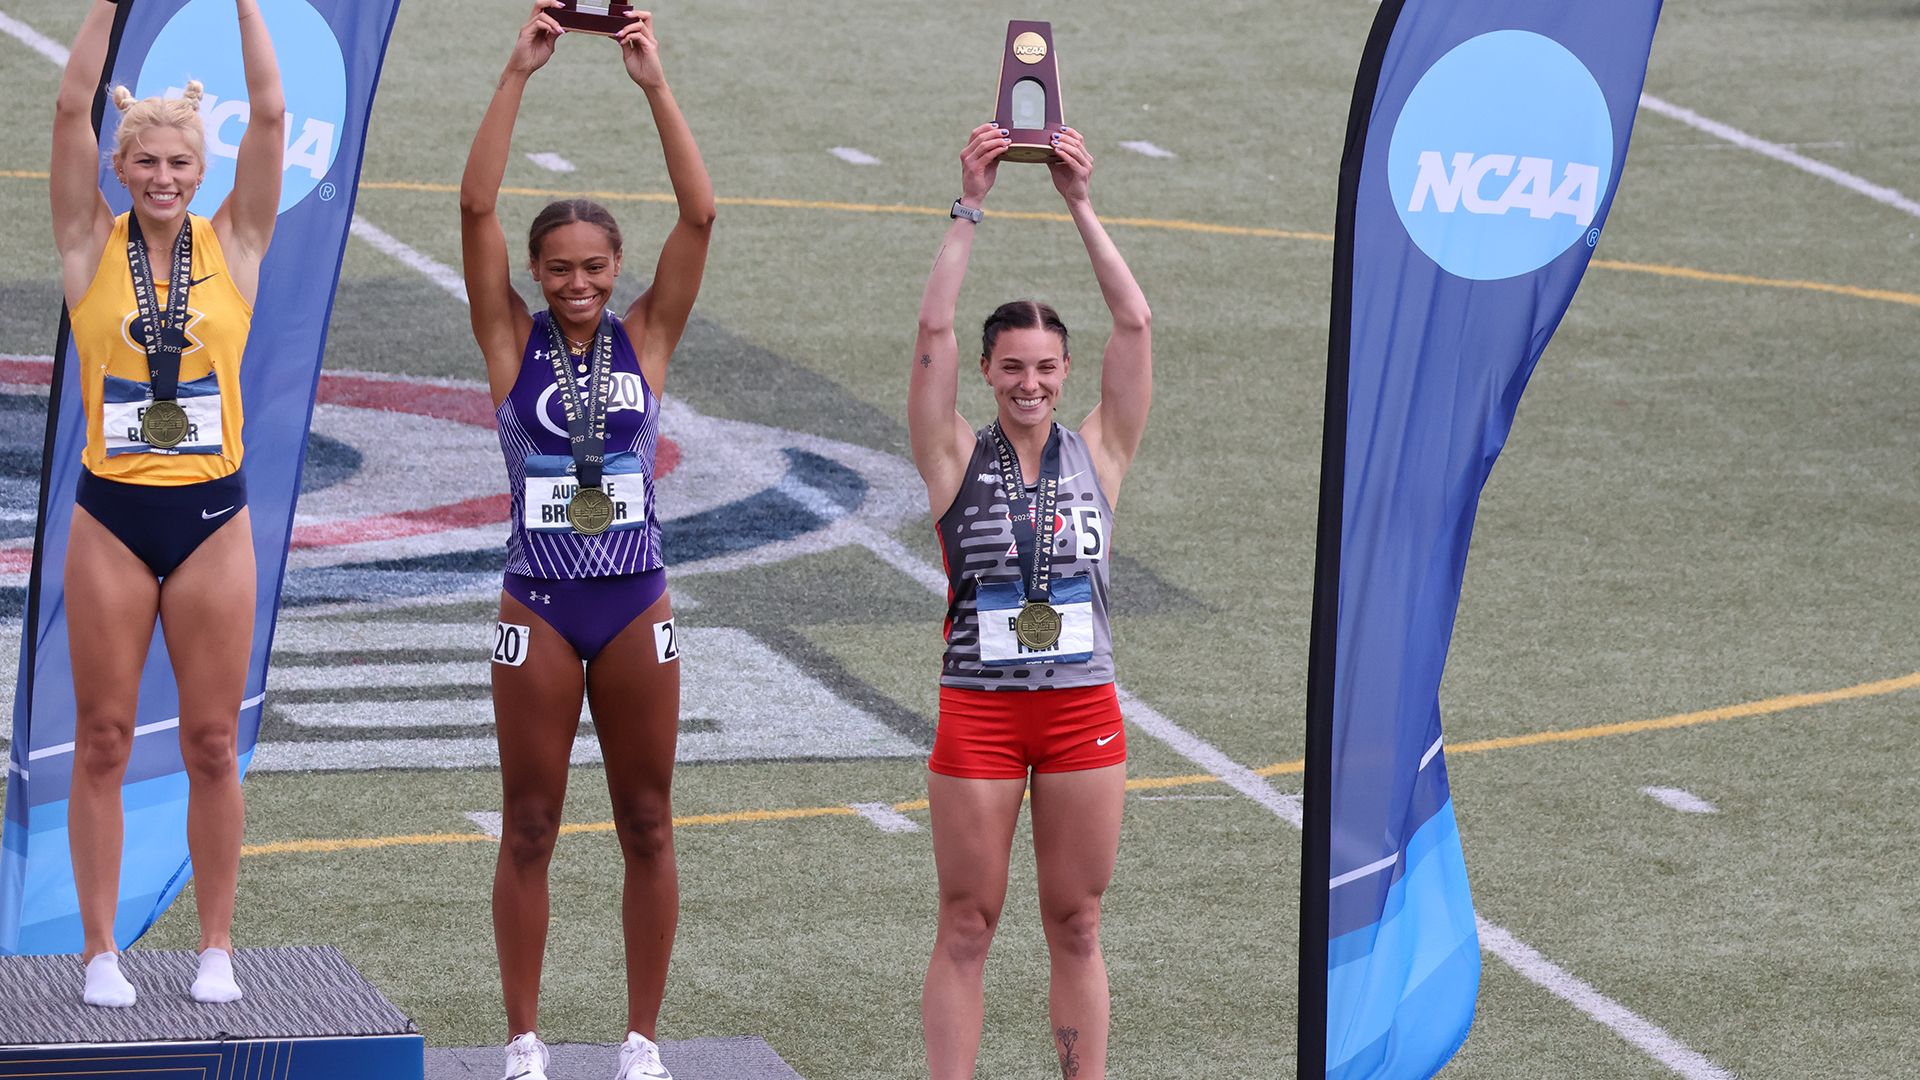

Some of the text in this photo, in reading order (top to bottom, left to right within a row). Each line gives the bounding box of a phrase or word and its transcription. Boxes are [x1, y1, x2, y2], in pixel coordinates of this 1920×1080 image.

[1016, 45, 1046, 56] NCAA
[1407, 151, 1599, 227] NCAA
[128, 241, 157, 355] ALL-AMERICAN
[163, 345, 182, 354] 2025
[595, 335, 612, 440] ALL-AMERICAN
[607, 374, 638, 408] 20
[571, 435, 585, 444] 202
[585, 455, 604, 463] 2025
[1013, 513, 1031, 522] 2025
[1039, 479, 1057, 592] ALL-AMERICAN
[1079, 510, 1101, 555] 5
[494, 624, 520, 663] 20
